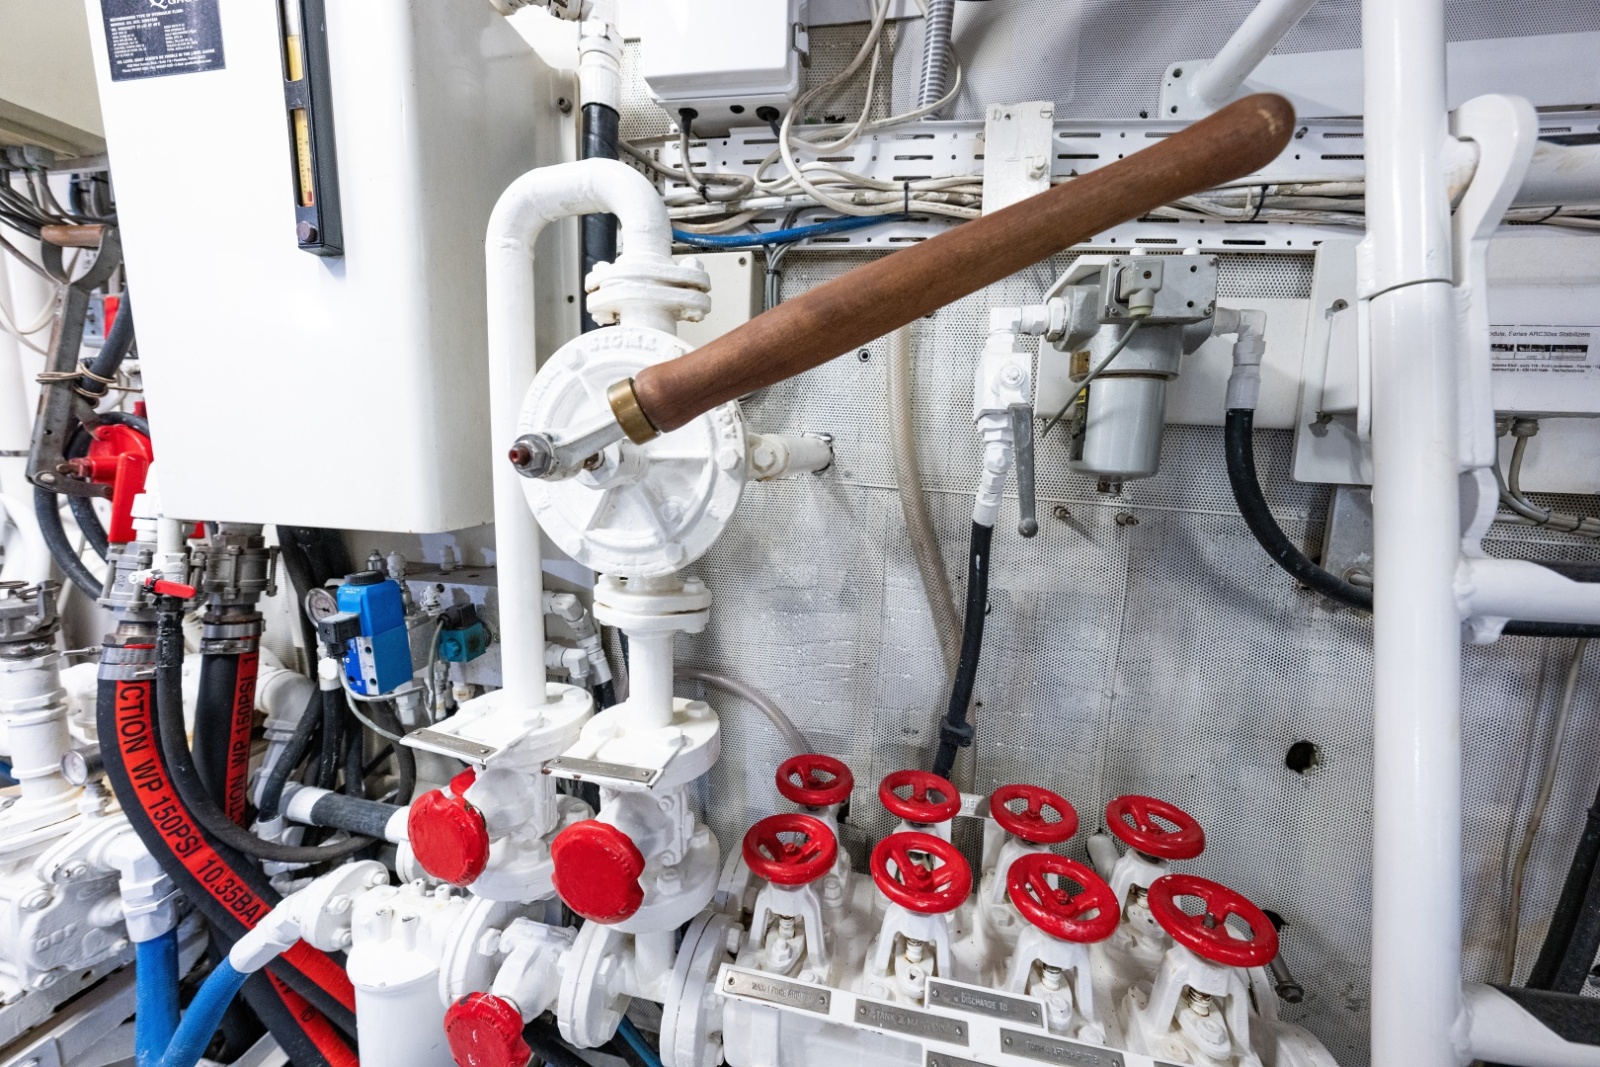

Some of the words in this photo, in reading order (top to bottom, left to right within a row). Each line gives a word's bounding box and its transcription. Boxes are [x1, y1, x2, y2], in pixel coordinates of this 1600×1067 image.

[236, 675, 254, 738] 150PSI
[231, 741, 248, 771] WP
[131, 758, 164, 793] WP
[148, 795, 204, 859] 150PSI
